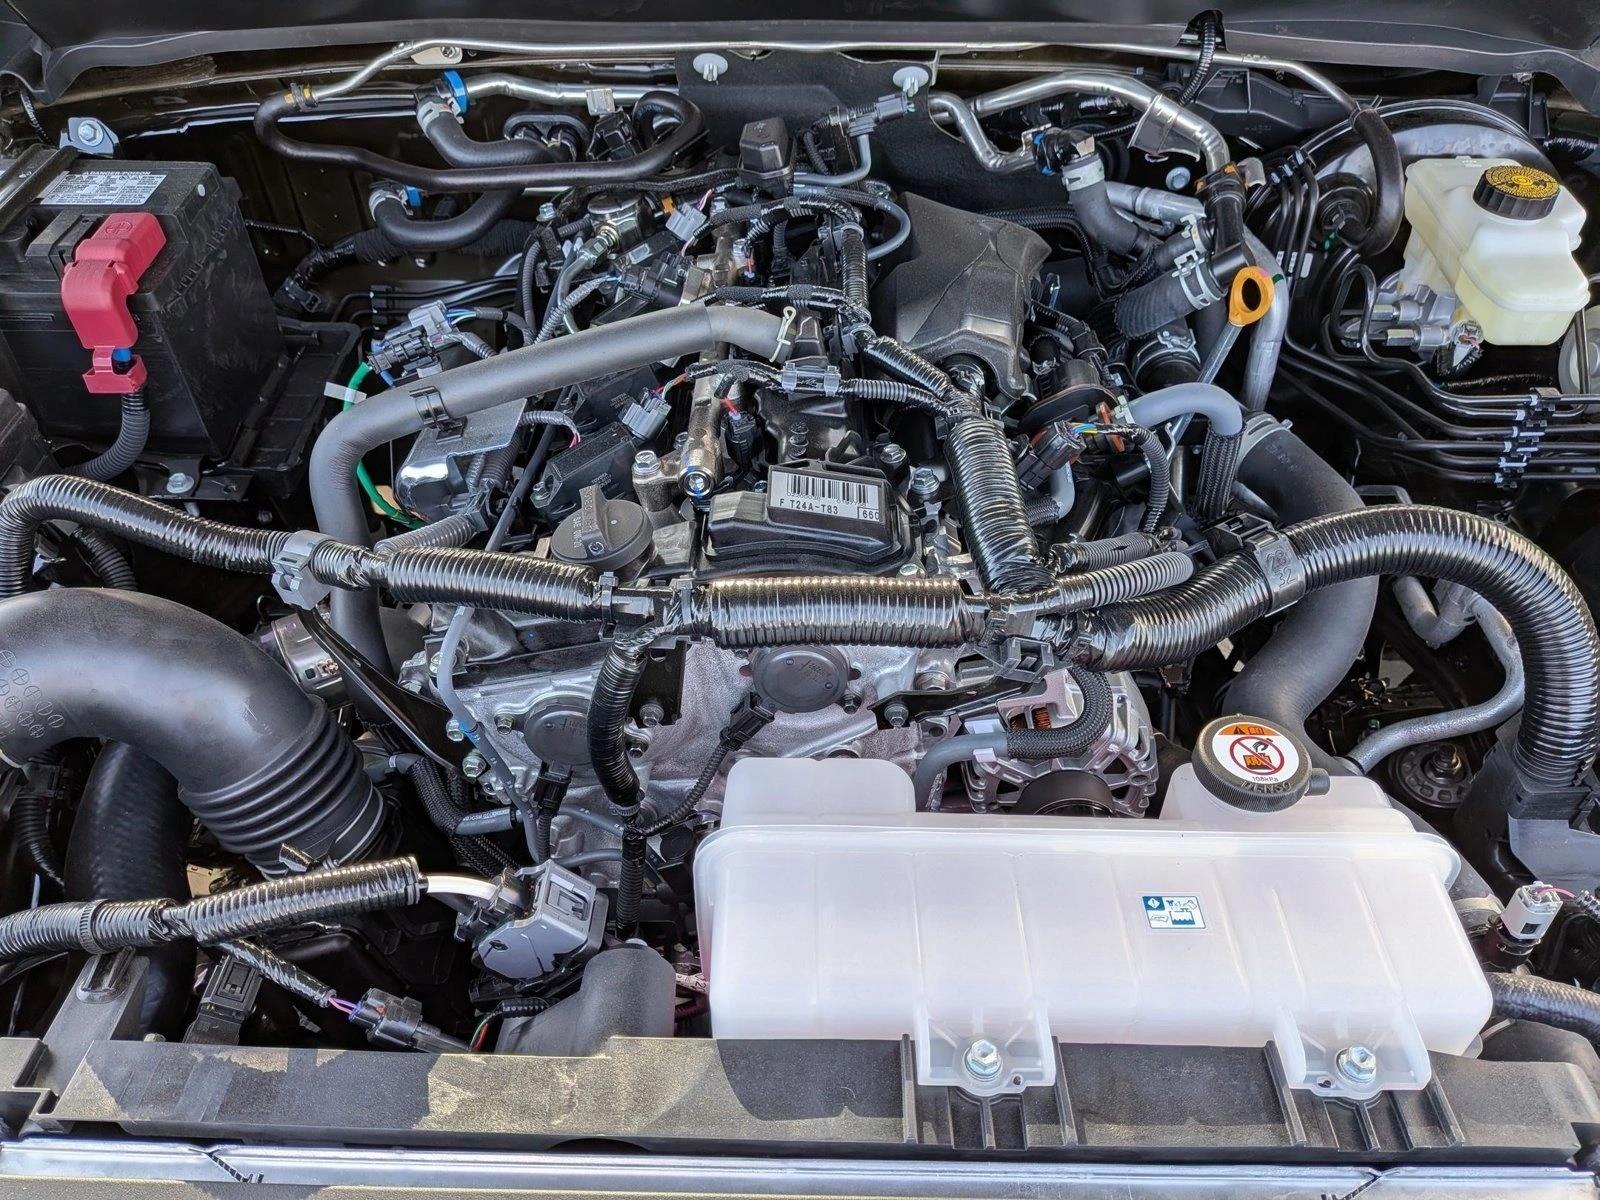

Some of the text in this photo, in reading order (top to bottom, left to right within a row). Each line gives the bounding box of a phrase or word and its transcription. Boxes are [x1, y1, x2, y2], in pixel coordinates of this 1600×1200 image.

[779, 498, 785, 507] F
[790, 499, 838, 515] T24A-T83
[1241, 780, 1292, 794] DENSO
